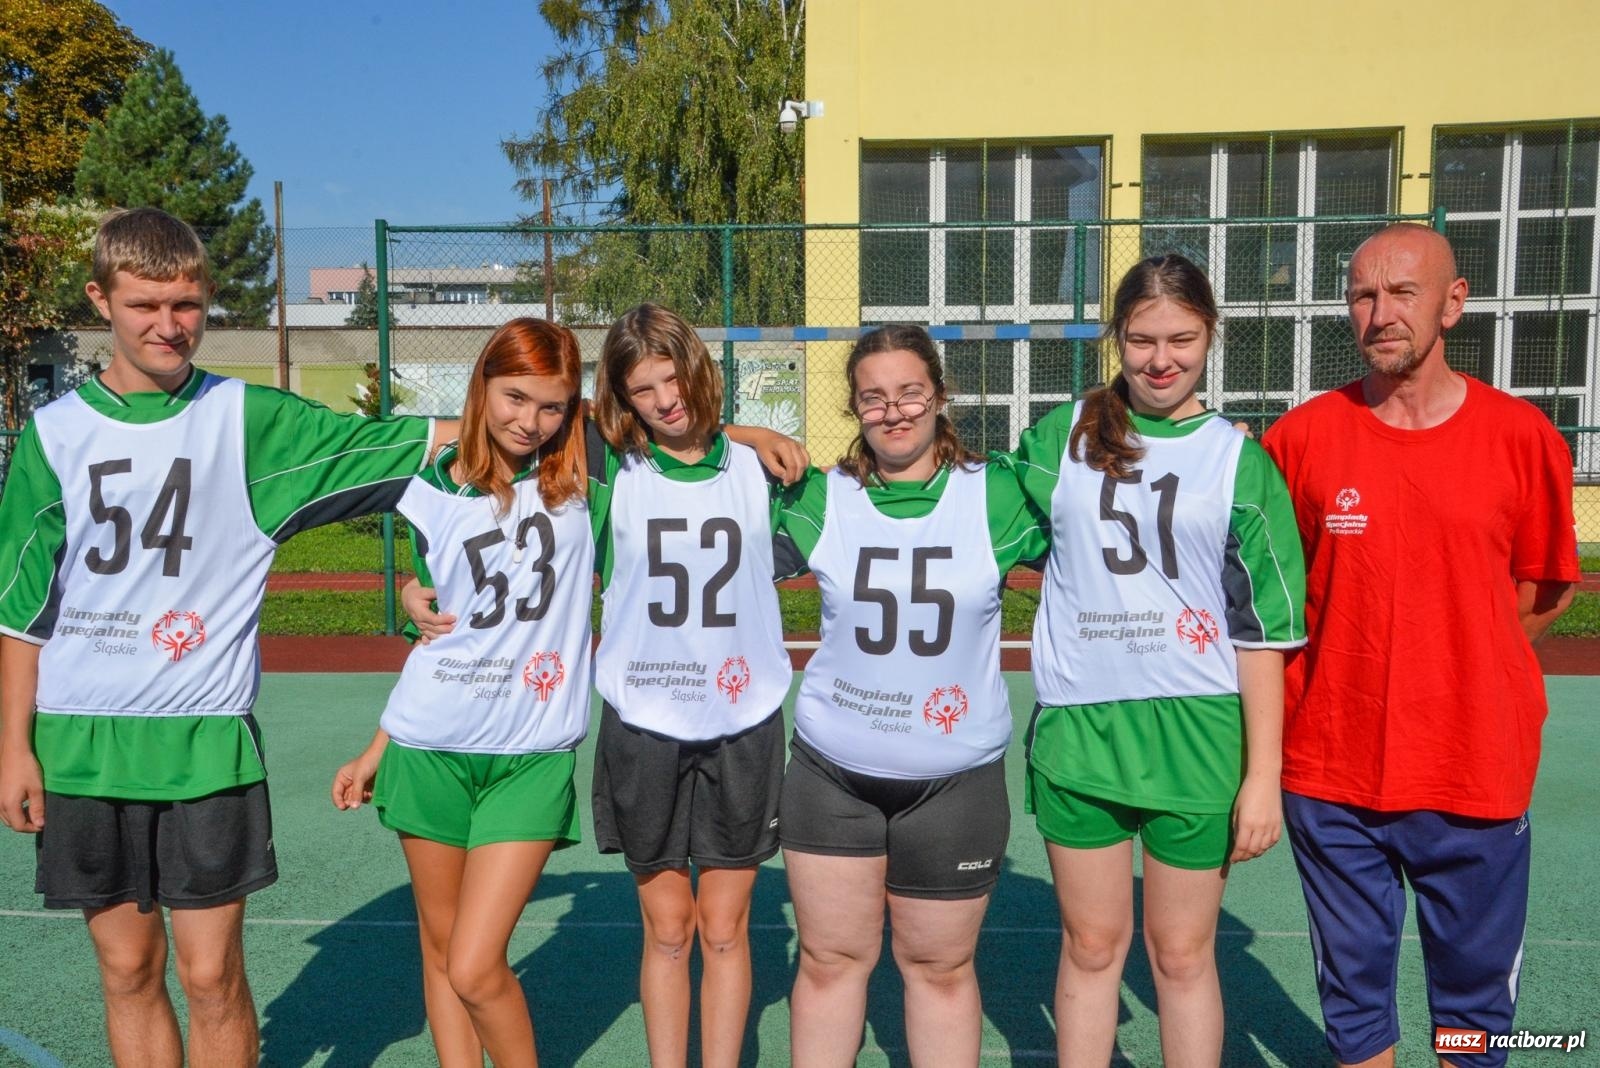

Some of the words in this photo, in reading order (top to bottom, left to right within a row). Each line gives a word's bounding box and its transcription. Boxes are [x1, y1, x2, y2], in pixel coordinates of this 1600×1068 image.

[738, 369, 778, 400] 4F
[85, 458, 192, 577] 54
[1100, 470, 1180, 579] 51
[463, 512, 555, 629] 53
[647, 517, 742, 628] 52
[853, 546, 955, 657] 55
[1077, 610, 1164, 625] Olimpiady
[1078, 626, 1166, 641] Specjalne
[93, 639, 137, 656] Śląskie
[1126, 641, 1167, 656] Śląskie
[437, 657, 515, 670] Olimpiady
[627, 660, 707, 675] Olimpiady
[432, 669, 512, 684] Specjalne
[625, 675, 707, 688] Specjalne
[473, 686, 512, 701] Śląskie
[670, 688, 707, 703] Śląskie
[833, 677, 913, 705] Olimpiady
[831, 692, 912, 718] Specjalne
[870, 718, 912, 734] Śląskie
[957, 859, 993, 870] COLO
